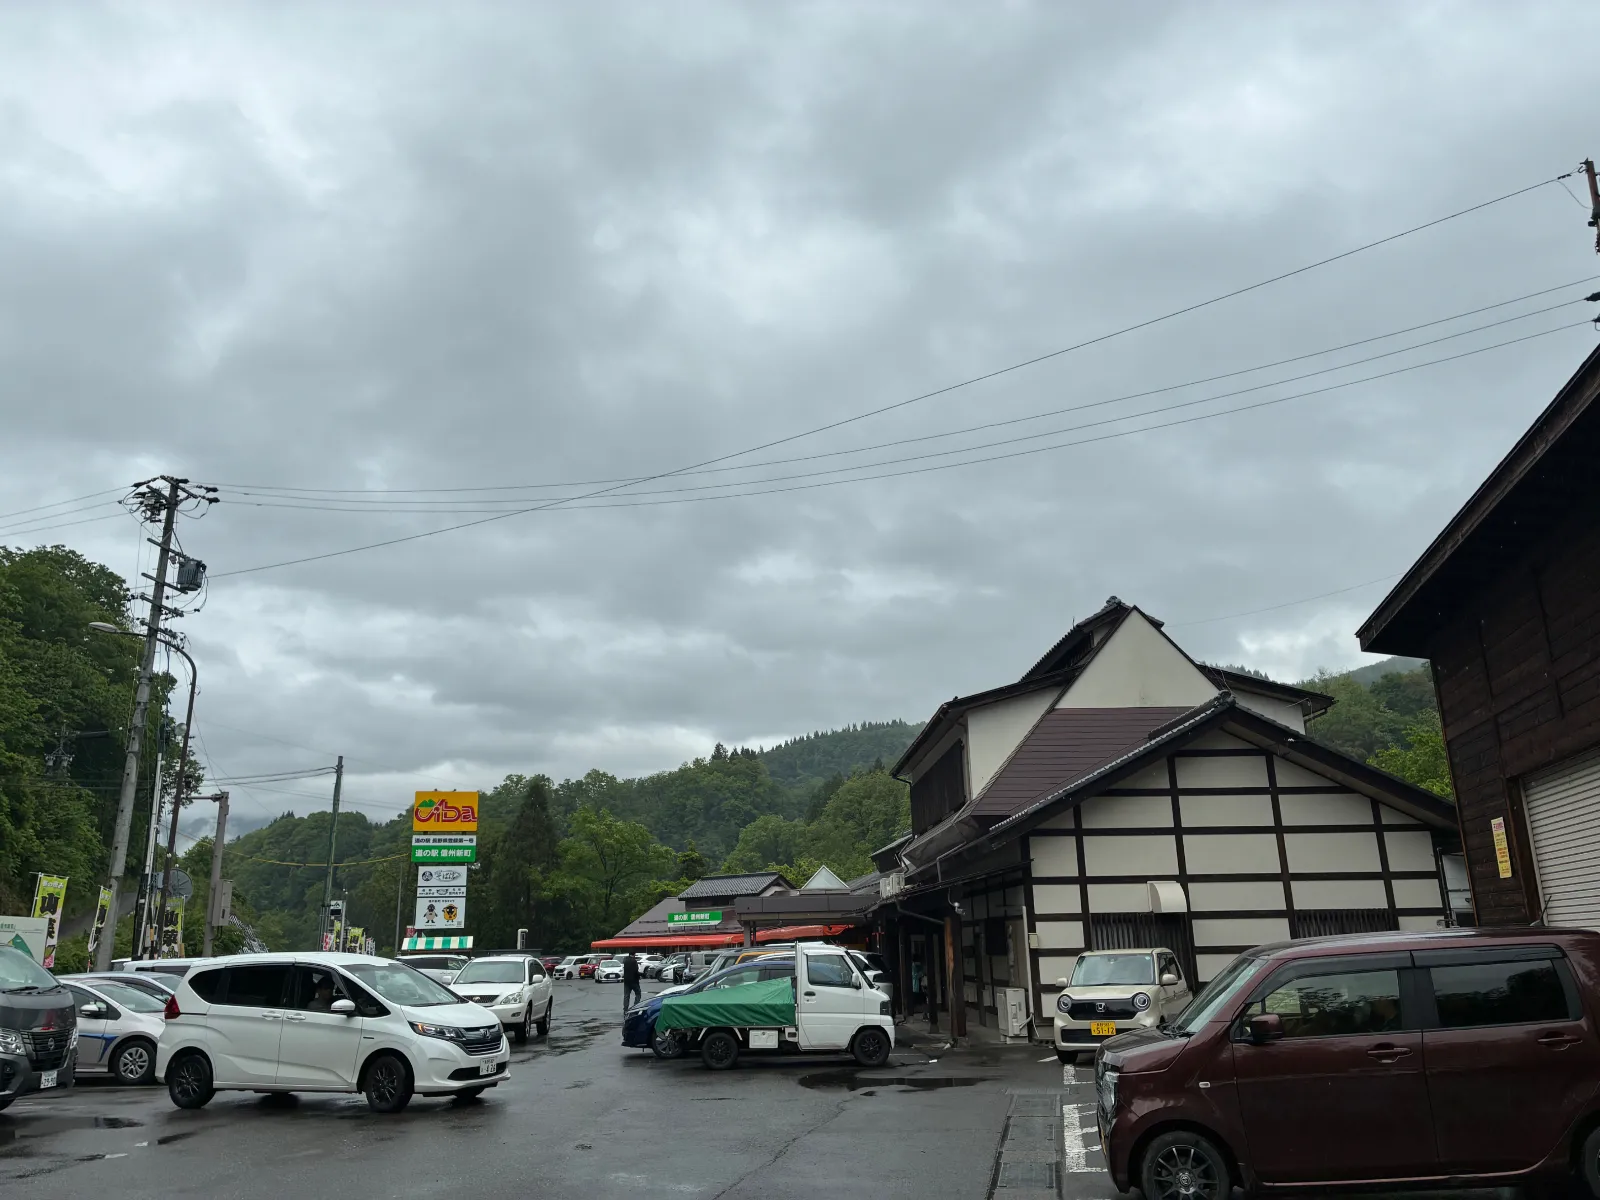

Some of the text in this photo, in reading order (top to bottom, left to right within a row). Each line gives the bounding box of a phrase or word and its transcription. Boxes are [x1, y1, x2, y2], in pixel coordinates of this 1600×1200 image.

[415, 849, 472, 857] 道の駅 信州新町
[1096, 1026, 1115, 1035] 51-12
